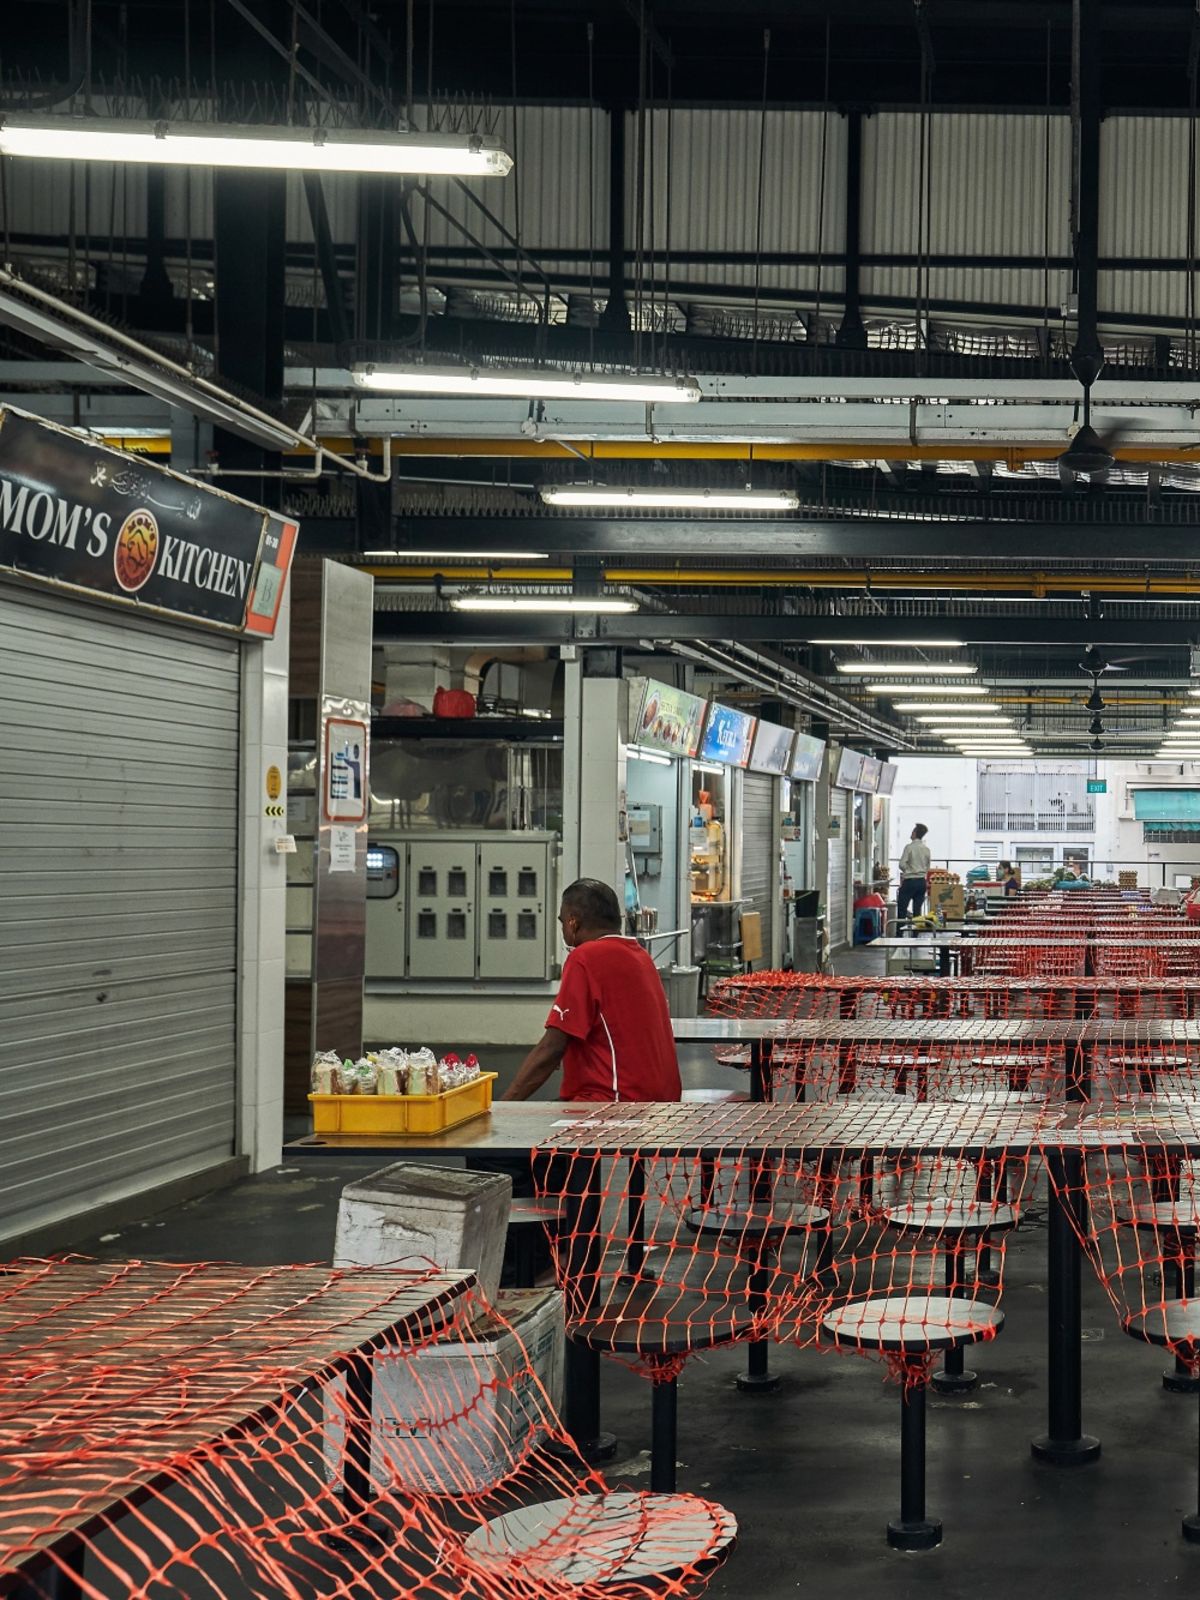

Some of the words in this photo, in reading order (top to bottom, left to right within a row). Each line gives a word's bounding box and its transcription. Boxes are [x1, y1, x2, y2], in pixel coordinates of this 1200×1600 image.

[0, 479, 112, 557] MOM'S
[157, 535, 252, 600] KITCHEN
[1090, 784, 1103, 792] EXIT
